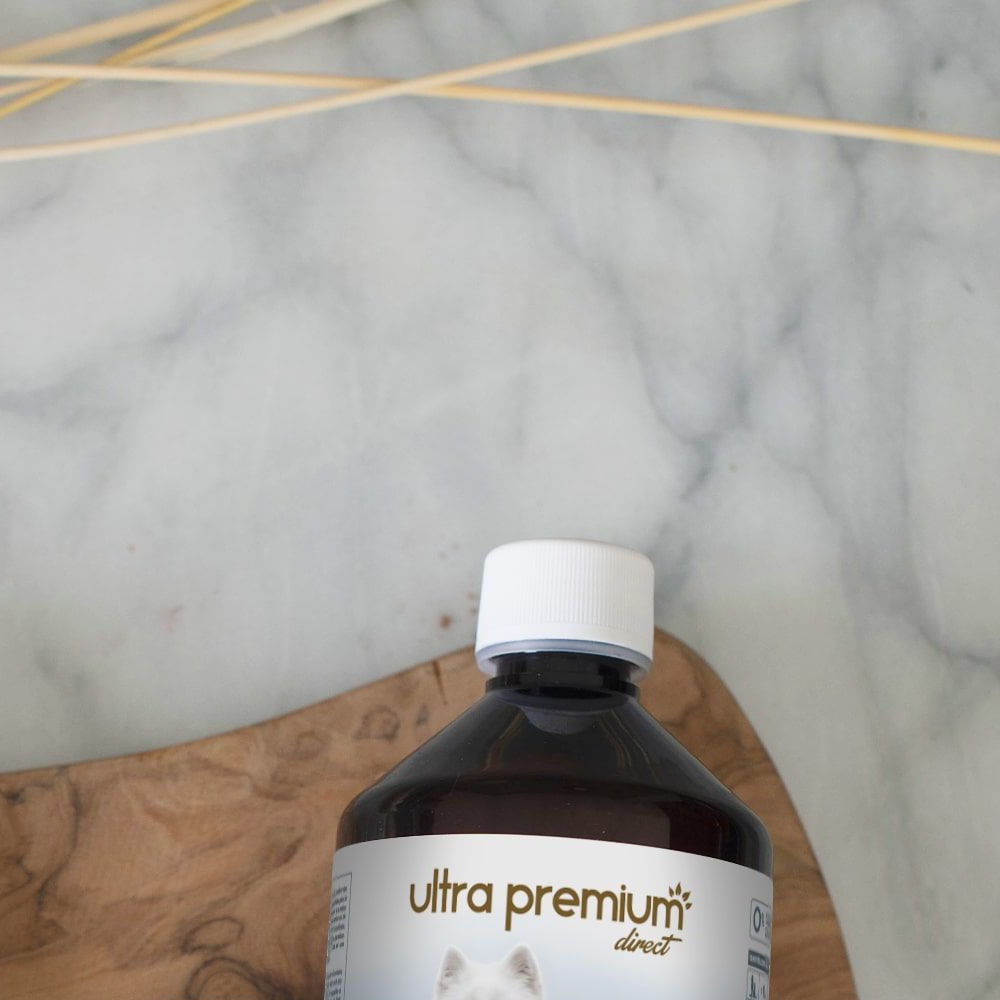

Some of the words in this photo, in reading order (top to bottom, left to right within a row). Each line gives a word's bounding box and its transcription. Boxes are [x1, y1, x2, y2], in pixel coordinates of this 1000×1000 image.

[409, 868, 493, 914] ultra
[505, 882, 690, 931] premium
[614, 926, 682, 957] direct
